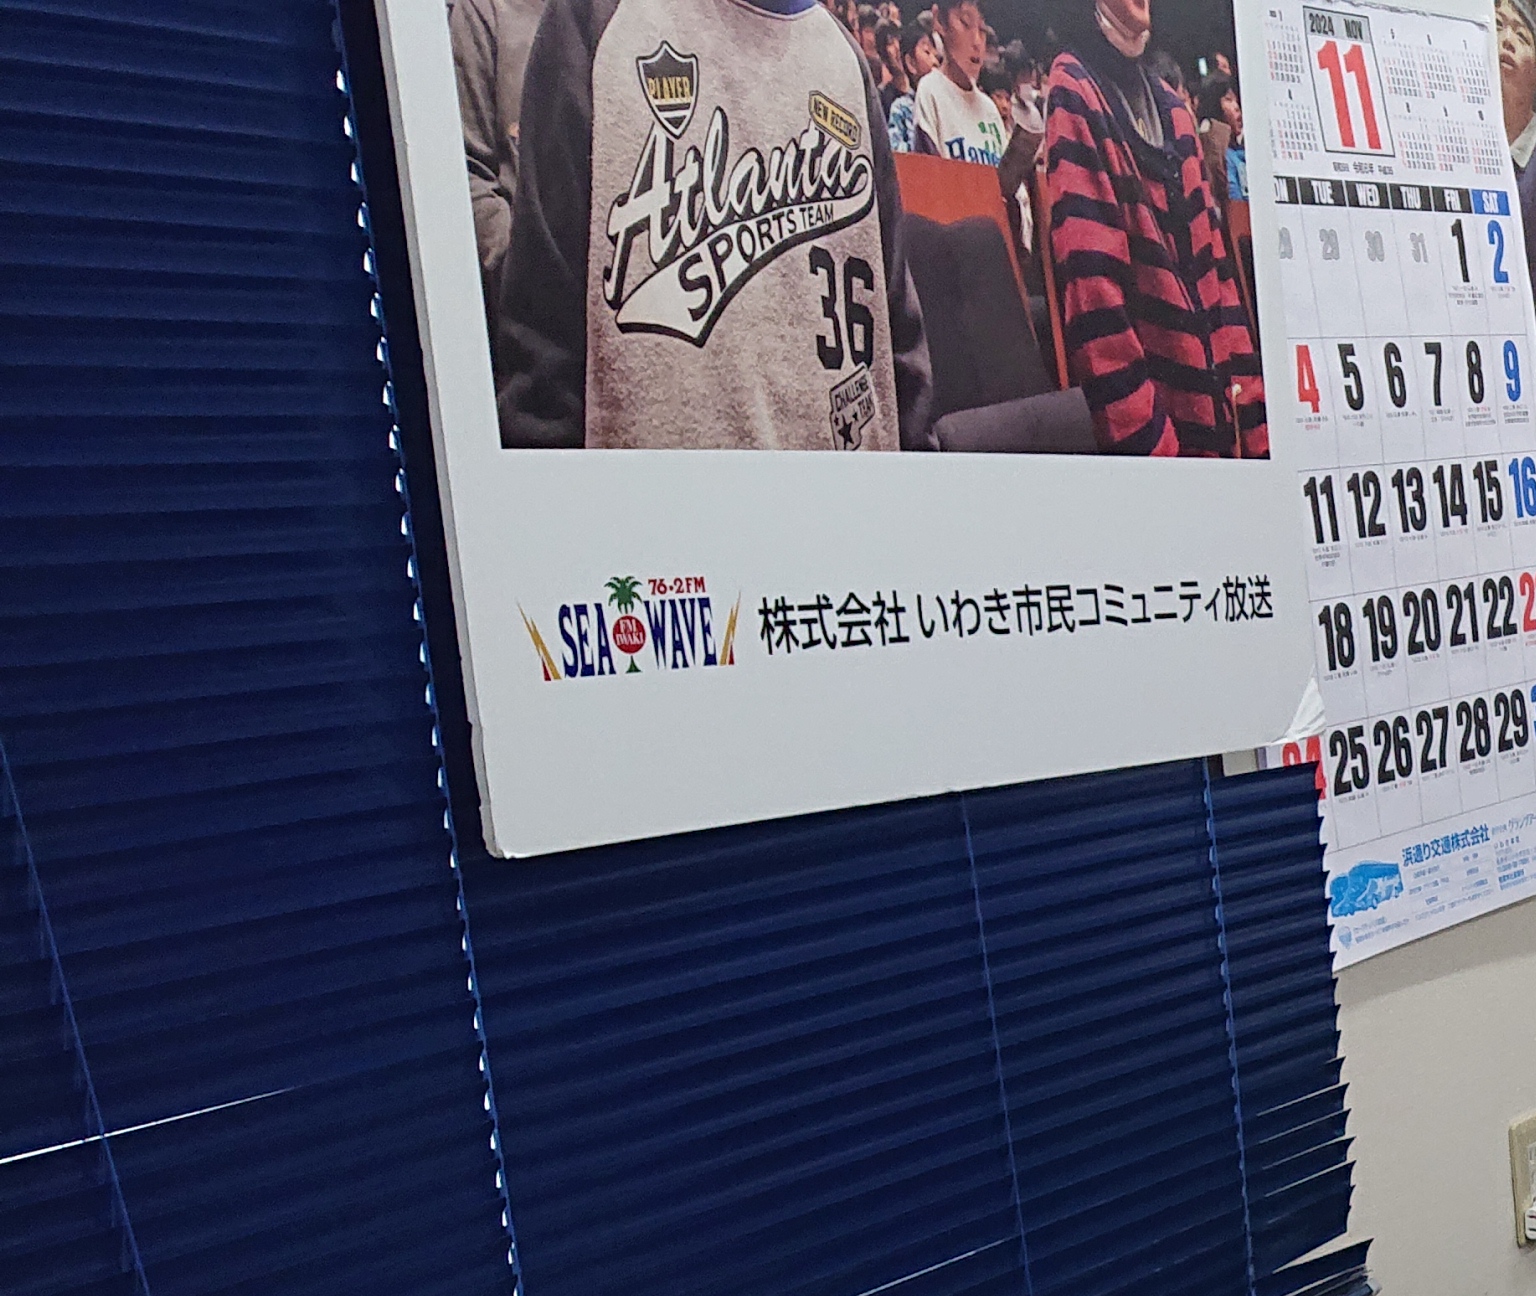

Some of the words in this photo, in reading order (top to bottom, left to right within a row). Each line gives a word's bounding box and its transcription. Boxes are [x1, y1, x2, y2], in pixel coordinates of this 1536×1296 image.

[1309, 13, 1334, 36] 2024
[1344, 19, 1363, 40] NOV
[647, 75, 692, 100] PLAYER
[813, 94, 830, 123] NEW
[1317, 40, 1382, 150] 11
[604, 105, 873, 310] Atlanta
[1311, 181, 1334, 204] TUE
[1356, 184, 1380, 206] WED
[1399, 182, 1421, 204] THU
[1444, 182, 1462, 205] FRI
[1482, 191, 1499, 213] SAT
[678, 211, 798, 322] SPORTS
[799, 202, 835, 231] TEAM
[1364, 231, 1386, 262] 30
[1409, 232, 1429, 263] 31
[1451, 219, 1470, 283] 1
[1487, 220, 1509, 283] 2
[809, 245, 875, 371] 36
[1295, 344, 1320, 413] 4
[1337, 344, 1364, 411] 5
[1383, 342, 1407, 408] 6
[1424, 342, 1442, 407] 7
[1466, 340, 1485, 404] 8
[1503, 340, 1521, 402] 9
[1303, 475, 1340, 544] 11
[1347, 471, 1386, 539] 12
[1391, 467, 1427, 533] 13
[1432, 464, 1468, 529] 14
[1472, 460, 1504, 523] 15
[559, 602, 616, 678] SEA
[644, 597, 718, 669] WAVE
[614, 631, 645, 647] IWAKI
[1318, 602, 1355, 671] 18
[1362, 595, 1398, 663] 19
[1402, 588, 1442, 656] 20
[1446, 582, 1479, 647] 21
[1483, 575, 1518, 640] 22
[1329, 725, 1370, 797] 25
[1373, 715, 1413, 785] 26
[1415, 705, 1449, 773] 27
[1456, 697, 1491, 763] 28
[1494, 689, 1529, 753] 29
[1402, 823, 1490, 867] 浜通り交通株式会社
